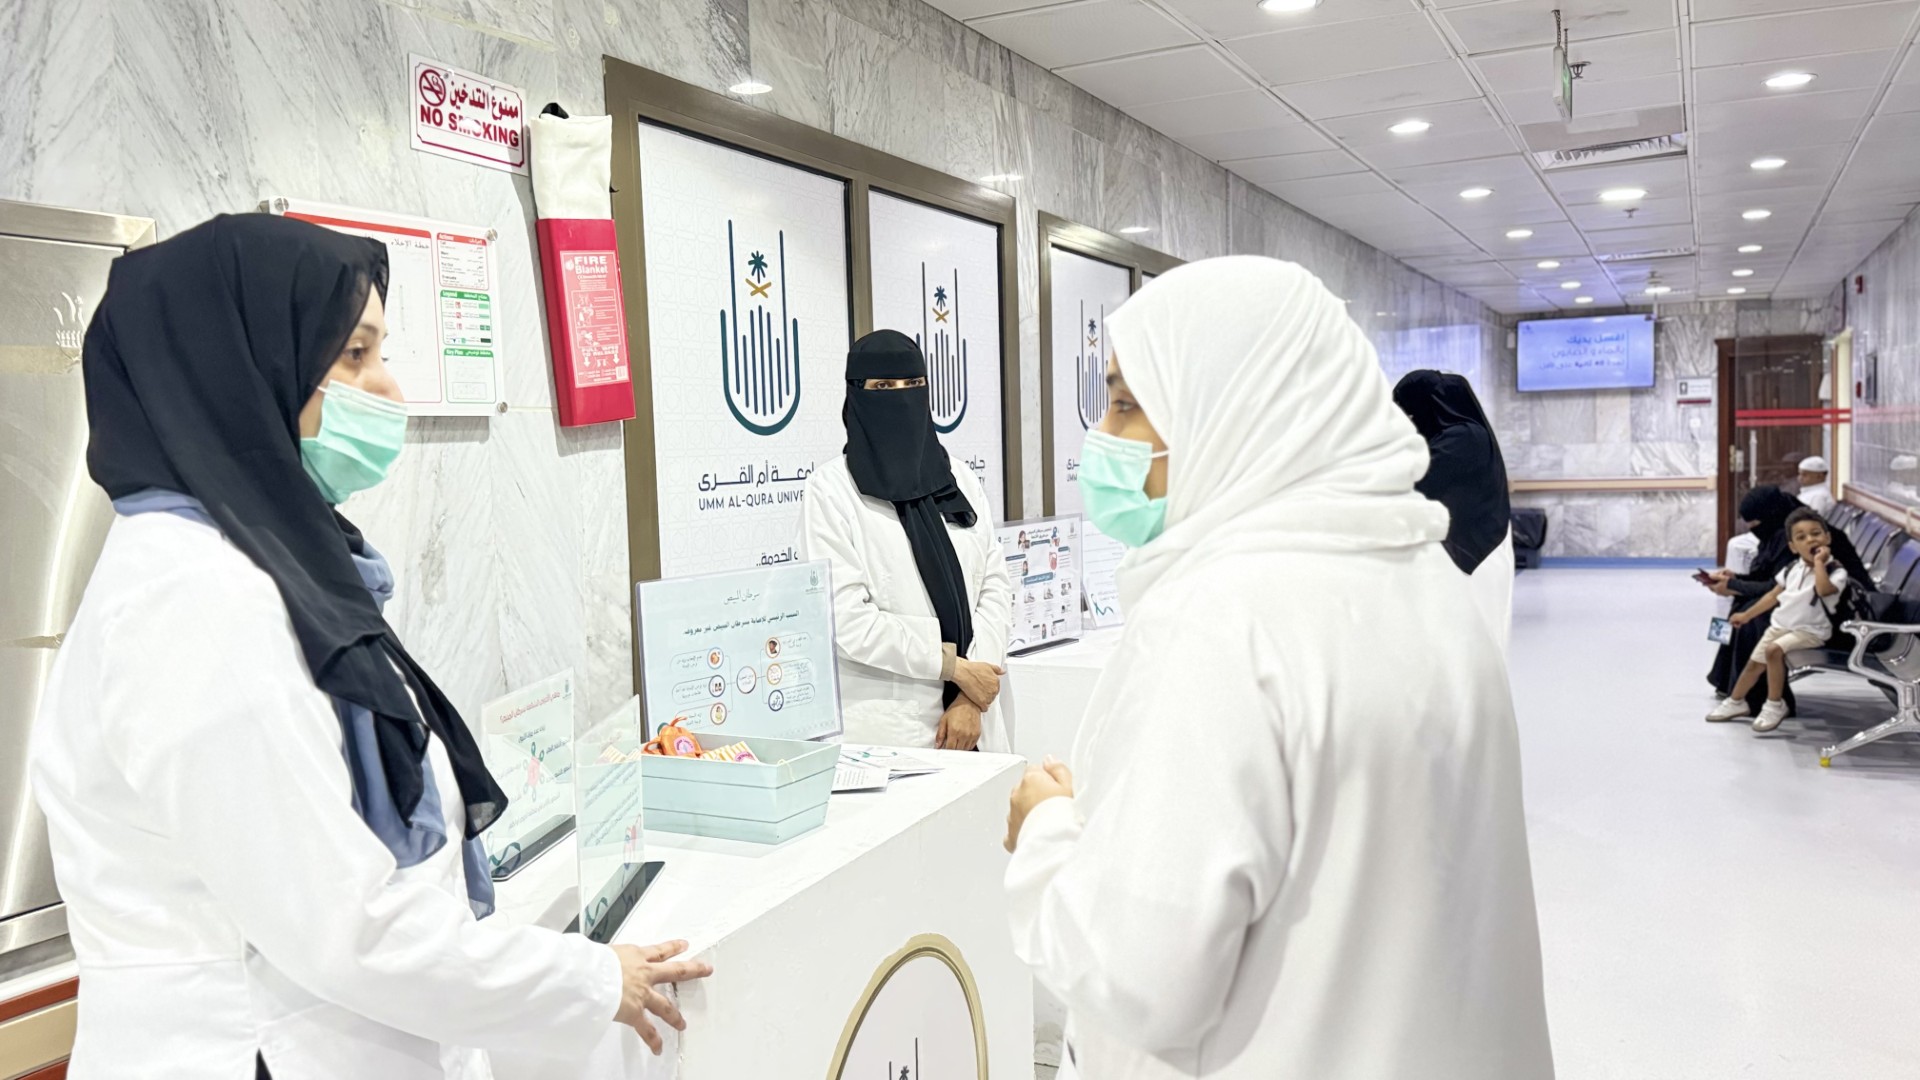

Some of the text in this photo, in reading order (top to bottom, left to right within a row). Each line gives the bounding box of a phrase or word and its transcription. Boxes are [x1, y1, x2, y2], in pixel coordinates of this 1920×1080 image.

[449, 80, 490, 110] التدخين
[420, 104, 444, 127] NO
[574, 255, 607, 265] FIRE
[575, 264, 608, 275] Blanket
[698, 464, 754, 492] القرى
[756, 459, 769, 488] أم
[698, 496, 725, 511] UMM
[728, 492, 774, 508] AL-QURA
